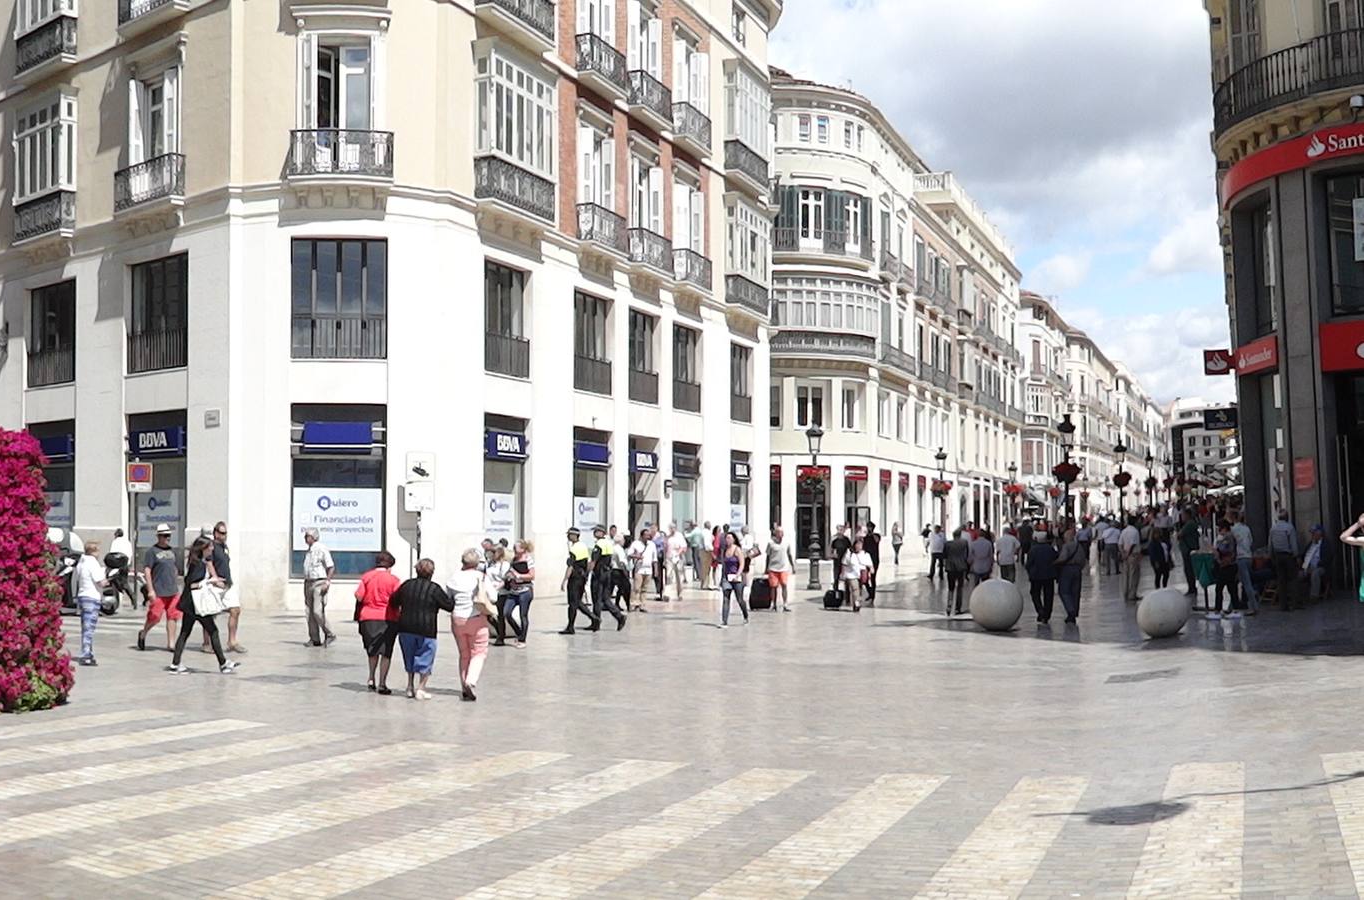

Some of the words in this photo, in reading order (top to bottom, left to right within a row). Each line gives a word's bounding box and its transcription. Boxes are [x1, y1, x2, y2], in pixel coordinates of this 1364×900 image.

[138, 431, 168, 449] BBVA
[496, 434, 521, 453] BBVA
[317, 495, 359, 511] Quiero
[313, 515, 374, 524] Financiación
